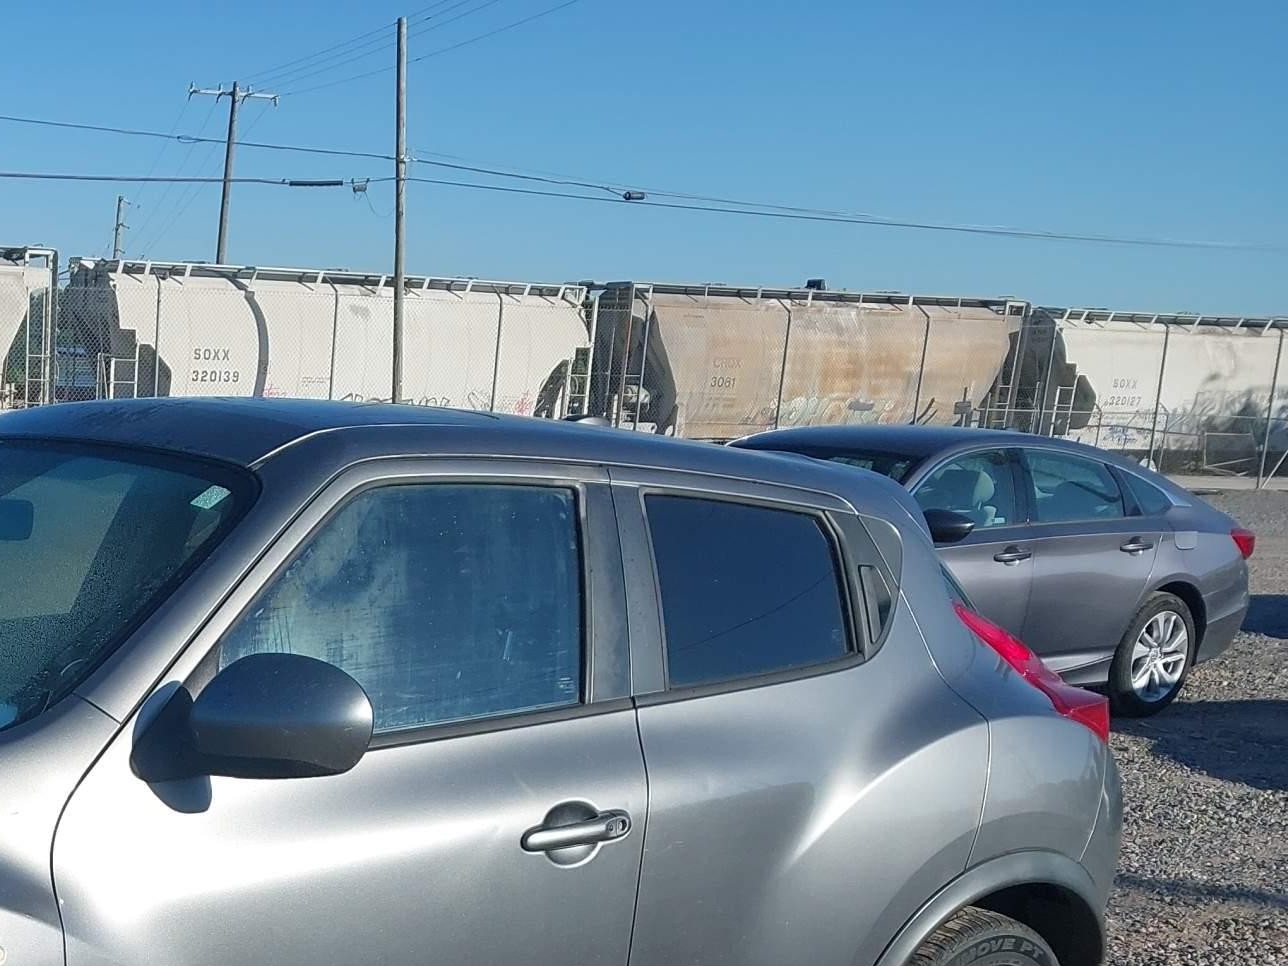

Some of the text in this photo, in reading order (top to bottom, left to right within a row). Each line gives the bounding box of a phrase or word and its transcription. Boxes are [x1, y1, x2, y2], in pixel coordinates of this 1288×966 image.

[193, 348, 230, 361] SOXX
[192, 370, 240, 383] 320139
[1112, 378, 1138, 390] SOXX
